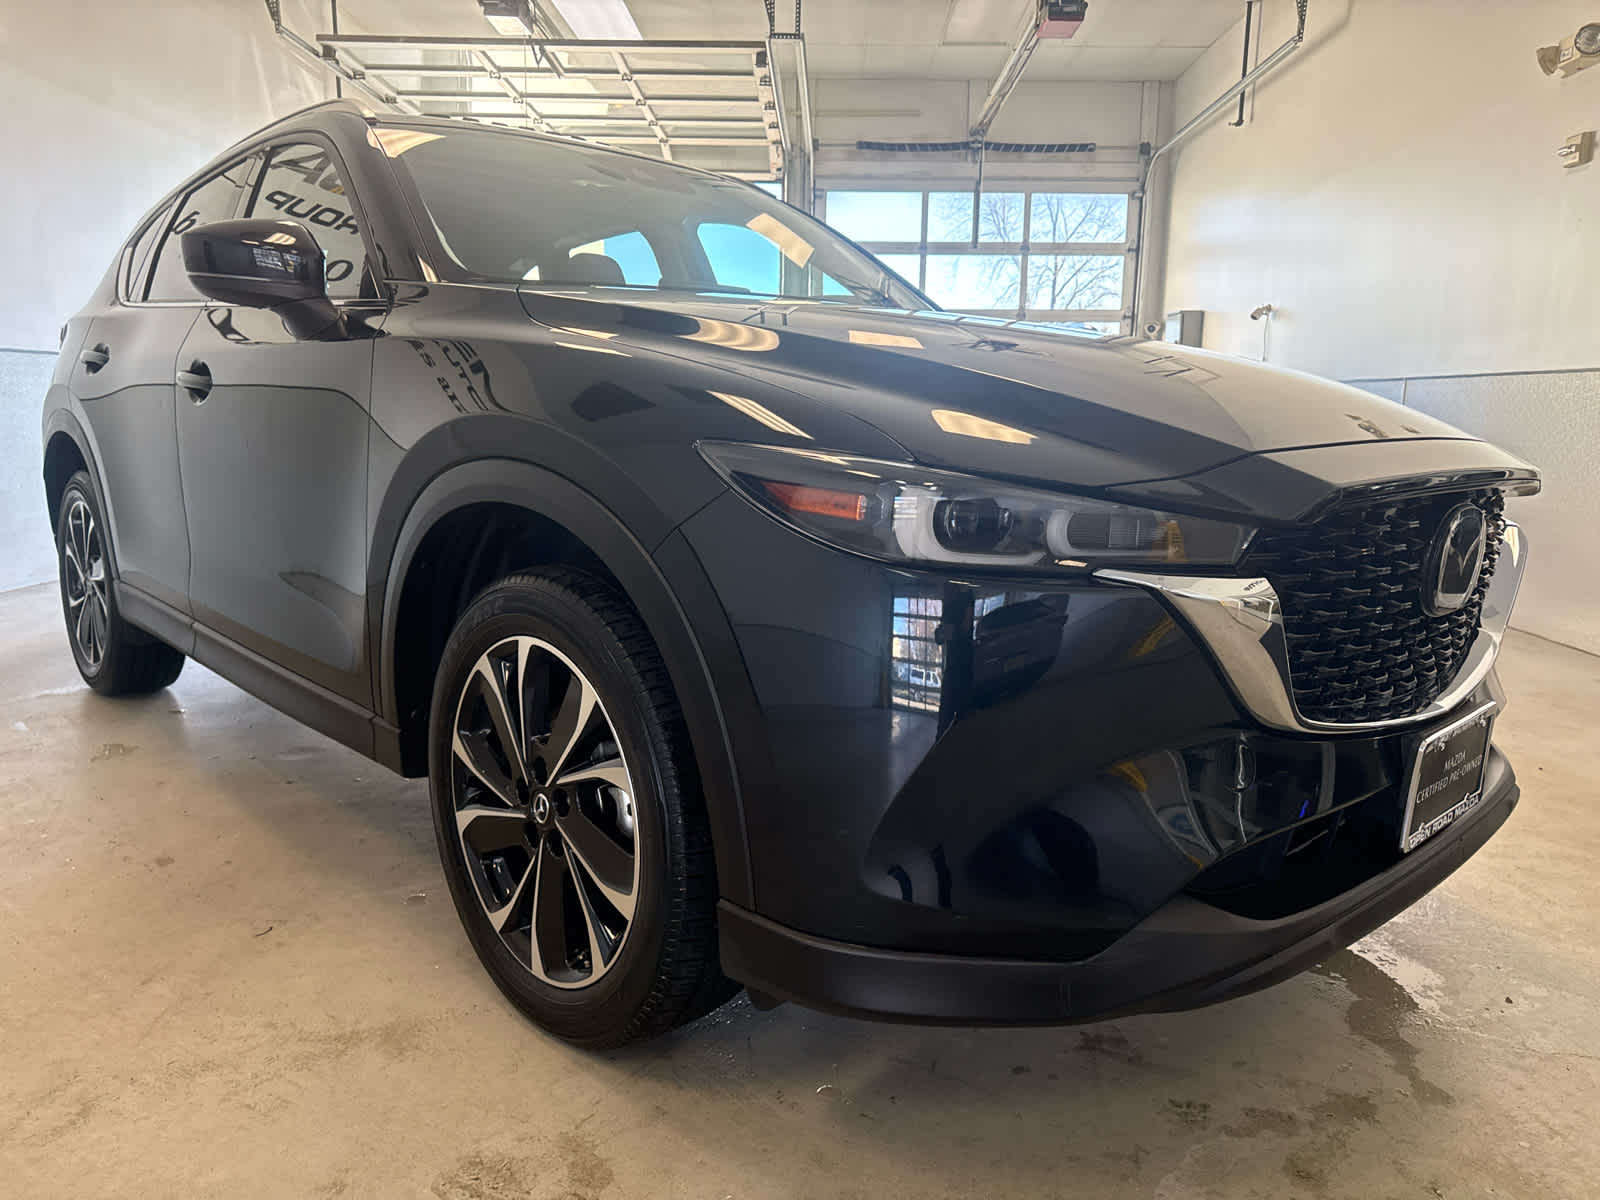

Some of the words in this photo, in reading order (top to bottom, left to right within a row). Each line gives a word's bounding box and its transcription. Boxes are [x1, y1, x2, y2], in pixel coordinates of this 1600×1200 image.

[1416, 776, 1449, 804] CERTIFIED
[1449, 754, 1482, 784] PRE-OWNED
[1444, 751, 1466, 770] MAZDA
[1432, 812, 1453, 833] ROAD
[1454, 796, 1479, 817] MAZDA
